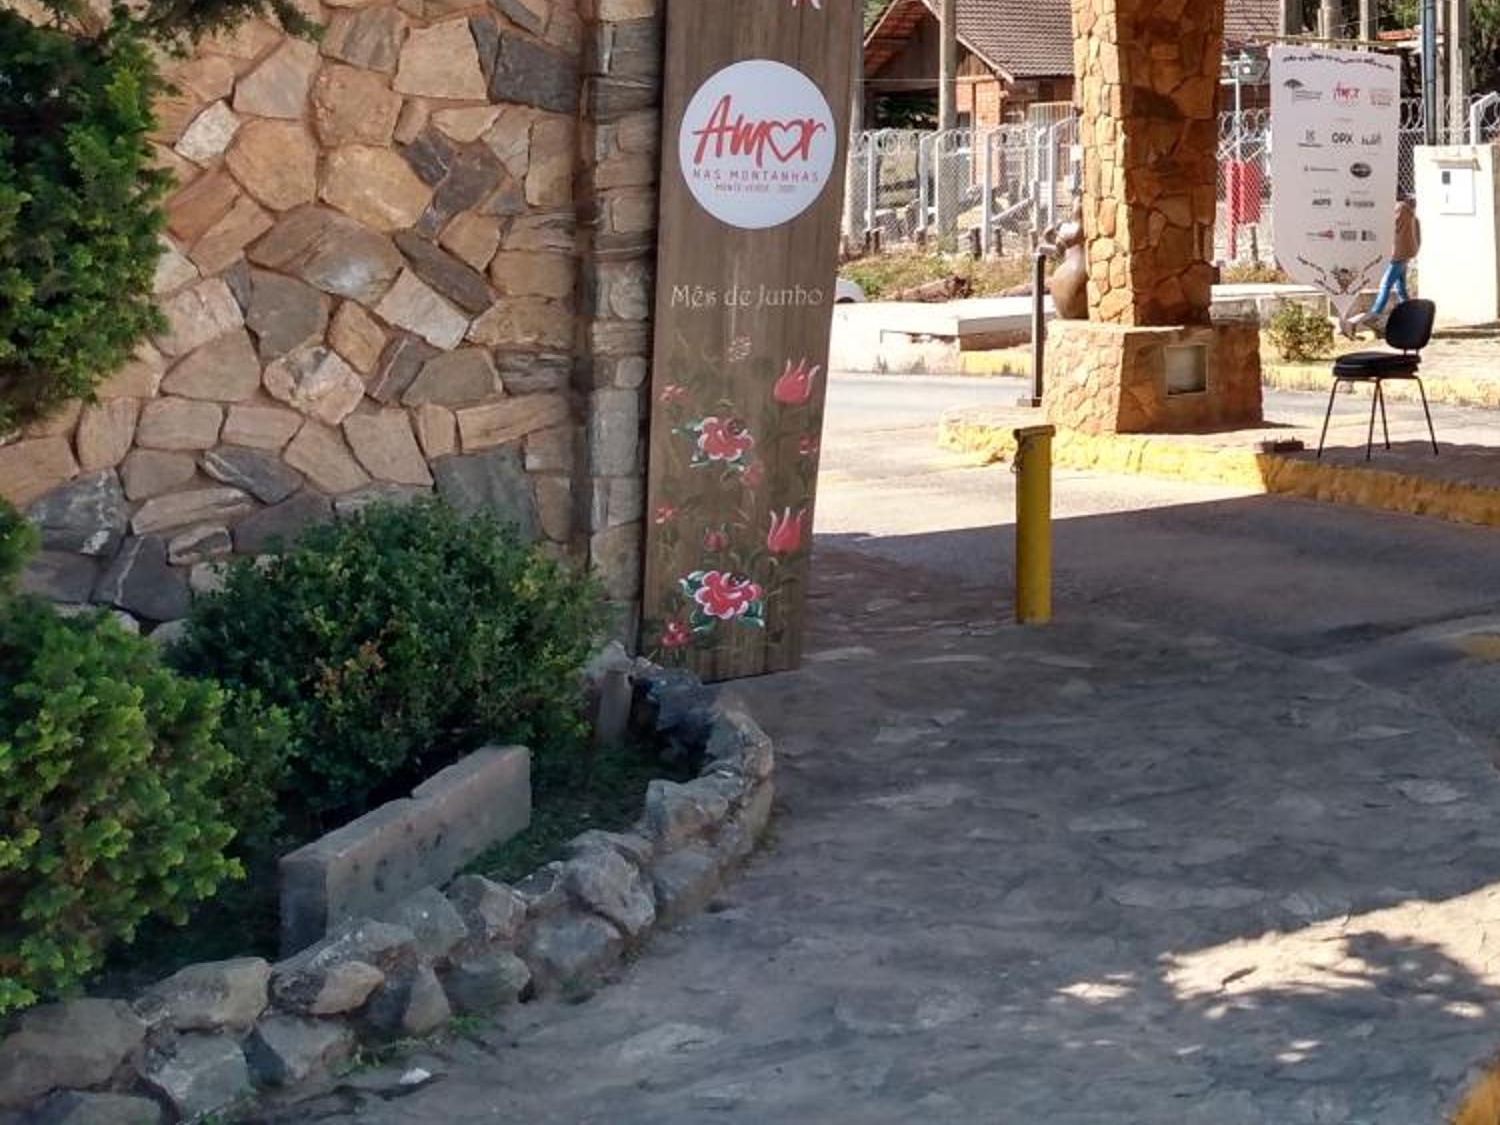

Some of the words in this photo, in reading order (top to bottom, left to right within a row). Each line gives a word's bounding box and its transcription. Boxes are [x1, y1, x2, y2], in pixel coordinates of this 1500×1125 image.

[671, 284, 718, 310] Mês
[724, 284, 752, 306] de
[757, 284, 824, 308] Junho
